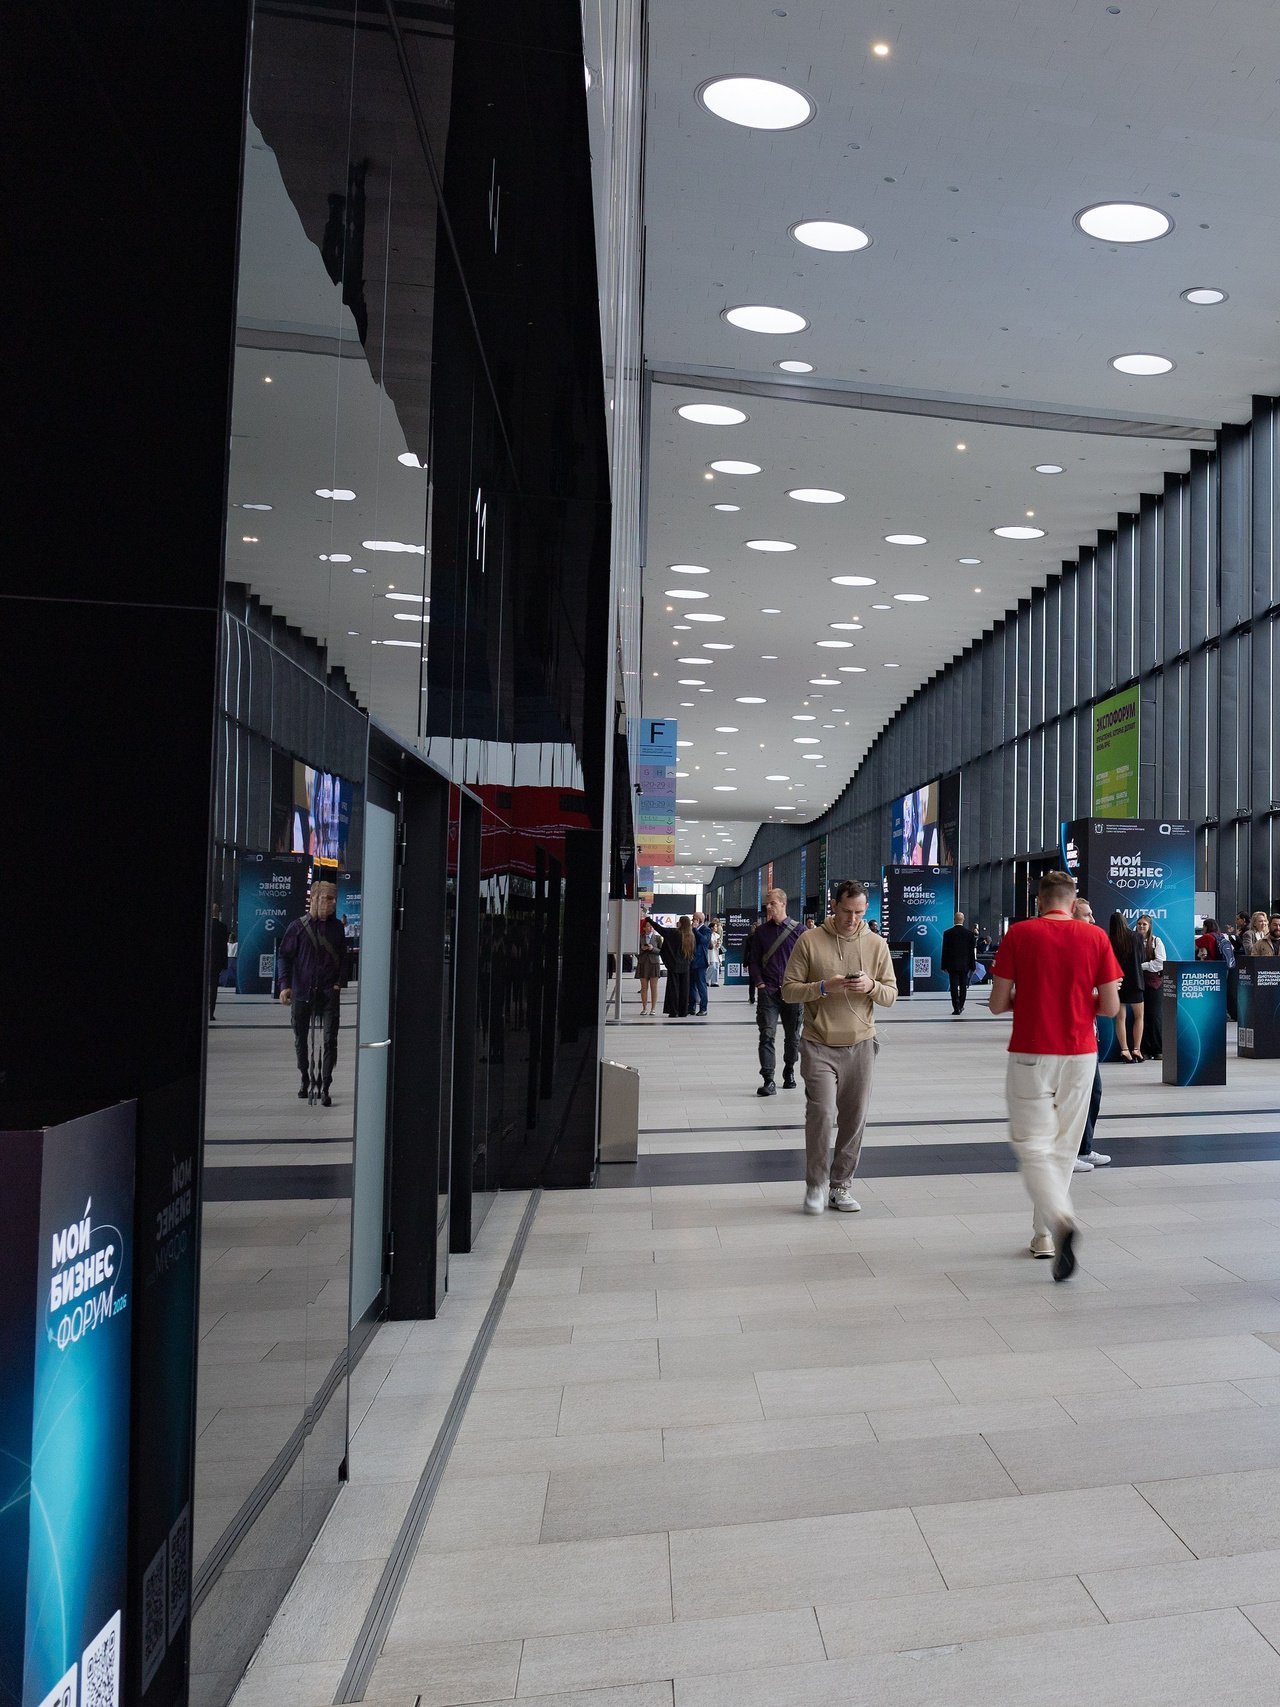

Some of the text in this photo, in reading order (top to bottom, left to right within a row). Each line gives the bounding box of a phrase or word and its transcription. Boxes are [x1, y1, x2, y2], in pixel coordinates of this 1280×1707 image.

[1096, 702, 1136, 732] ЭКСПОФОРУМ
[651, 723, 665, 743] F
[1110, 851, 1141, 866] МОЙ
[1110, 867, 1163, 877] БИЗНЕС
[904, 884, 922, 892] МОЙ
[1116, 879, 1164, 889] ФОРУМ
[1116, 908, 1167, 919] МИТАП
[917, 925, 927, 935] 3
[52, 1196, 91, 1269] МОЙ
[50, 1244, 114, 1312] БИЗНЕС
[57, 1285, 127, 1351] ФОРУМ 2026
